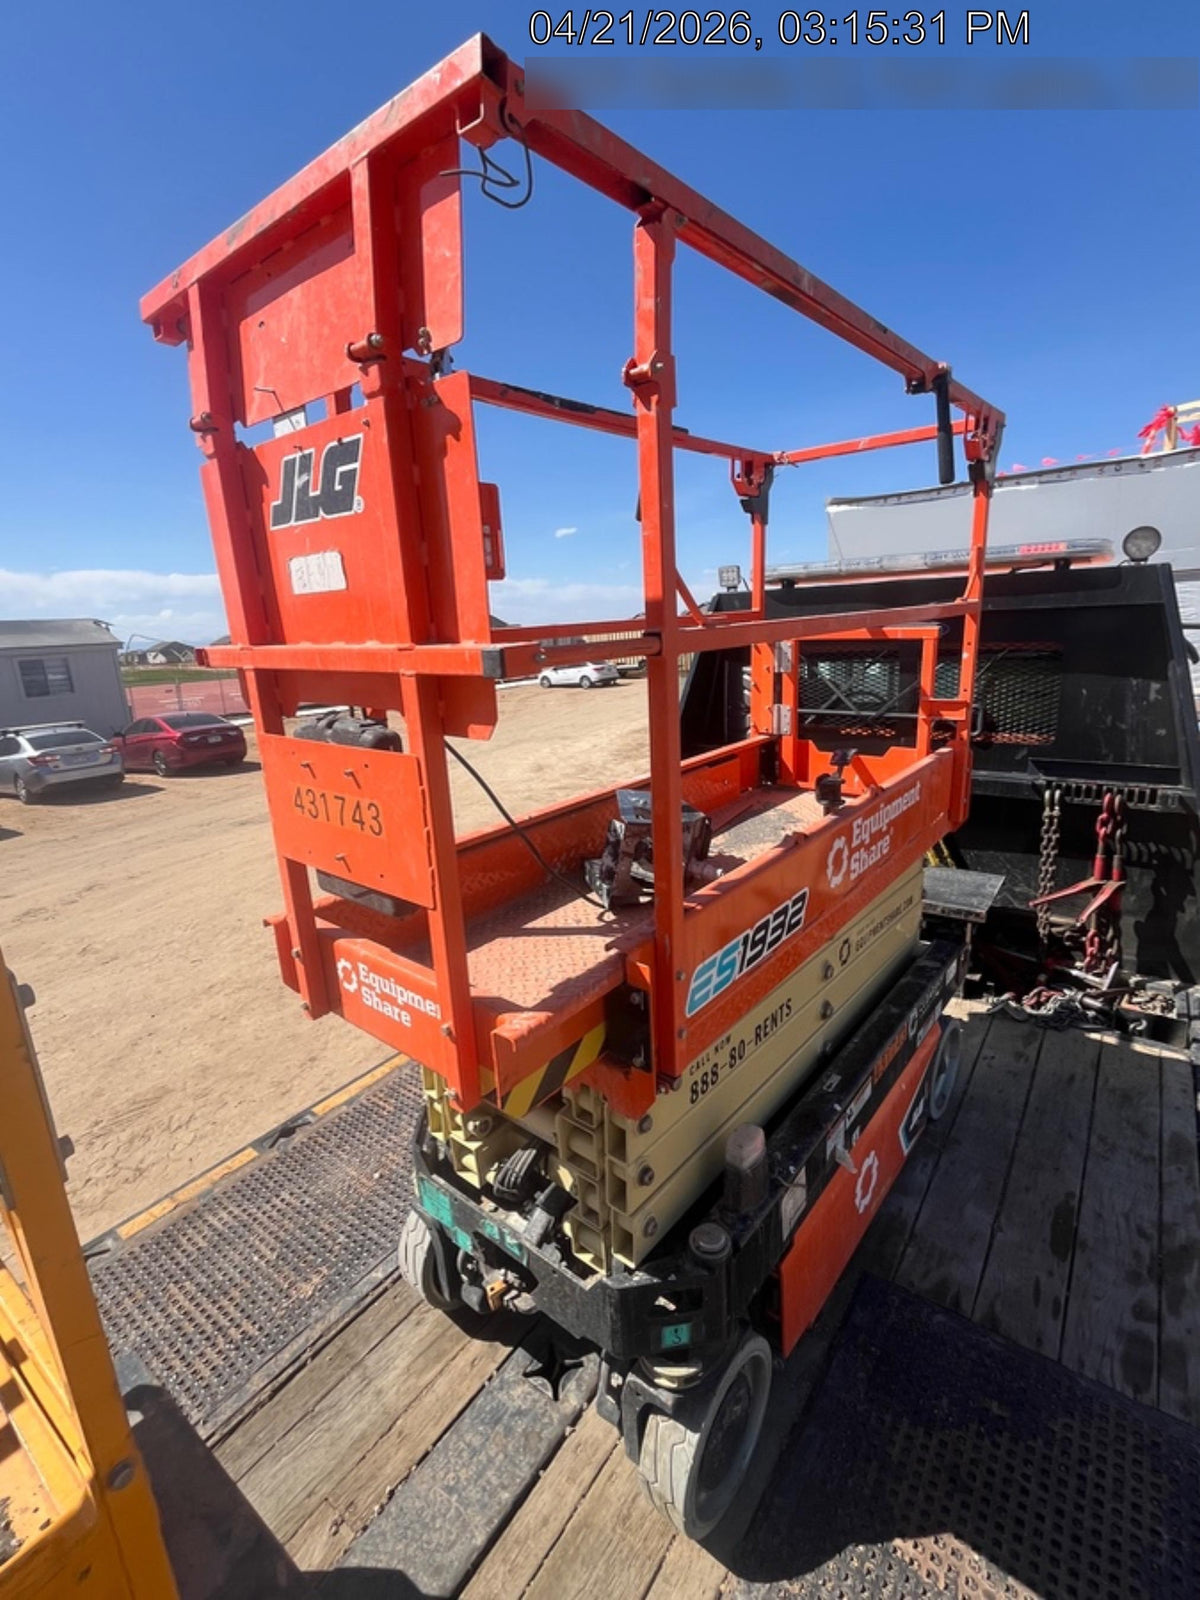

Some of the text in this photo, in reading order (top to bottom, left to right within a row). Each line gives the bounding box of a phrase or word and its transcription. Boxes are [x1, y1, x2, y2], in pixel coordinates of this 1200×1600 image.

[270, 432, 364, 530] JLG
[294, 786, 383, 837] 431743
[852, 780, 920, 848] Equipment
[850, 834, 891, 880] Share
[686, 887, 809, 1018] ES1932
[361, 985, 412, 1028] Share
[689, 997, 792, 1104] 888-80-RENTS
